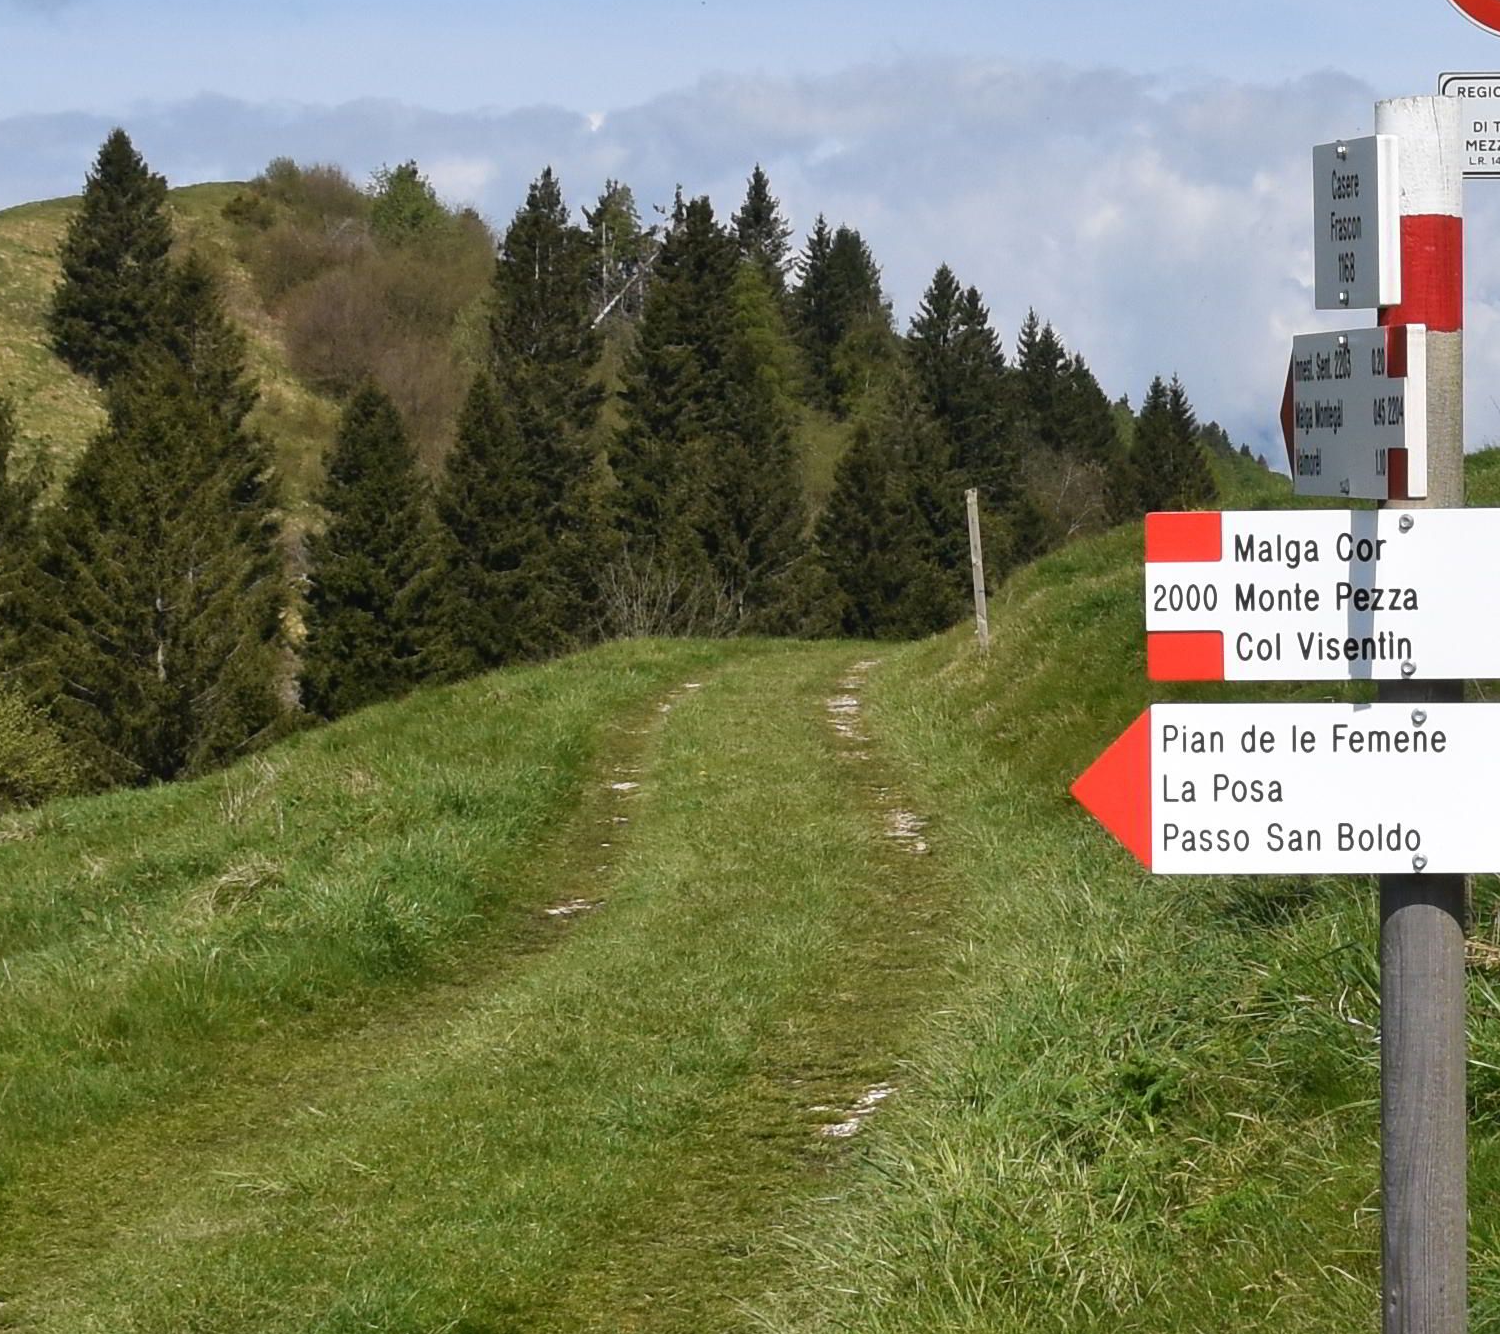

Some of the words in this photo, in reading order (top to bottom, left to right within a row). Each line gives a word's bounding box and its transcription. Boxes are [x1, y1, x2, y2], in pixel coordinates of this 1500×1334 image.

[1473, 121, 1487, 132] DI
[1331, 170, 1359, 200] Casere
[1330, 211, 1362, 241] Frascon
[1338, 252, 1355, 283] 1168
[1236, 535, 1318, 567] Malga
[1336, 533, 1386, 562] Cor
[1155, 584, 1217, 611] 2000
[1237, 584, 1318, 610] Monte
[1337, 583, 1417, 611] Pezza
[1238, 634, 1279, 660] Col
[1164, 725, 1223, 752] Pian
[1242, 726, 1274, 752] de
[1293, 726, 1315, 752] le
[1334, 726, 1445, 752] Femene
[1164, 776, 1195, 802] La
[1214, 774, 1282, 802] Posa
[1164, 824, 1249, 851] Passo
[1268, 823, 1320, 851] San
[1339, 823, 1420, 851] Boldo
